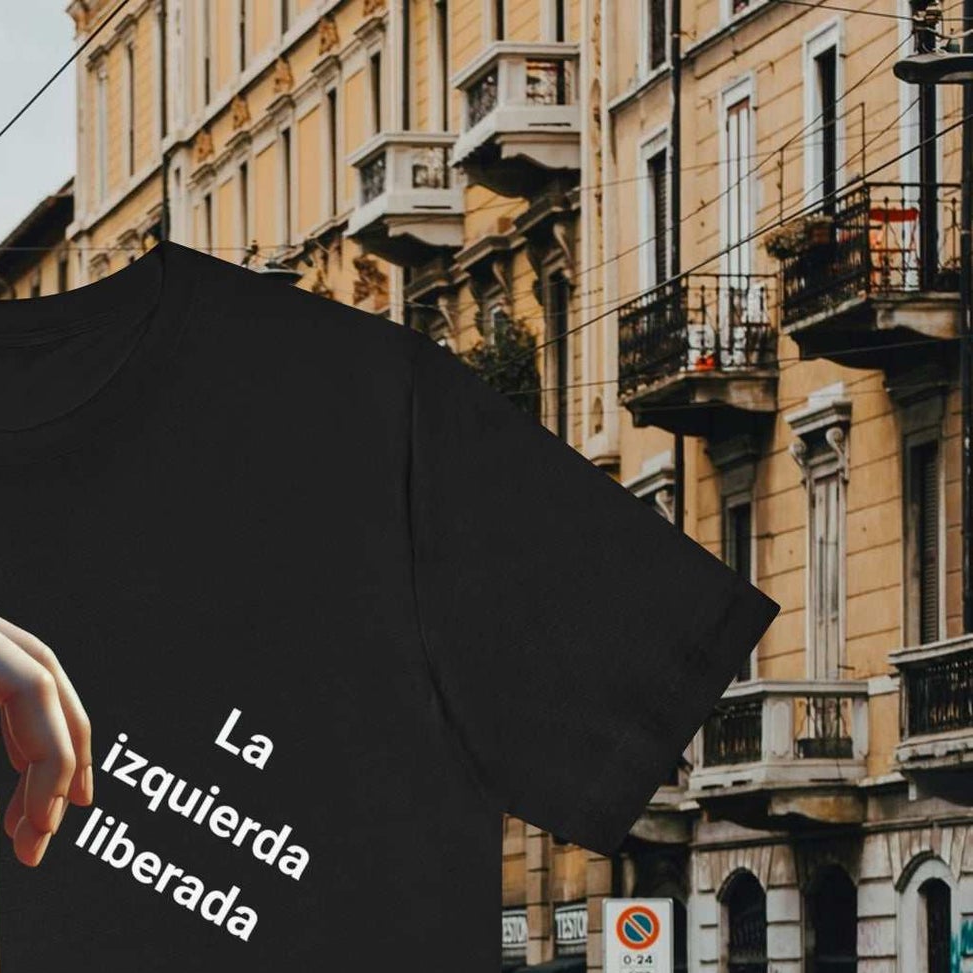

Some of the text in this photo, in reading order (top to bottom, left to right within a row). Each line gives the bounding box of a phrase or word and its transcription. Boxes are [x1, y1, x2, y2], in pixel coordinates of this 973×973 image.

[214, 708, 274, 770] La
[100, 733, 311, 881] izquierda
[75, 808, 259, 942] liberada
